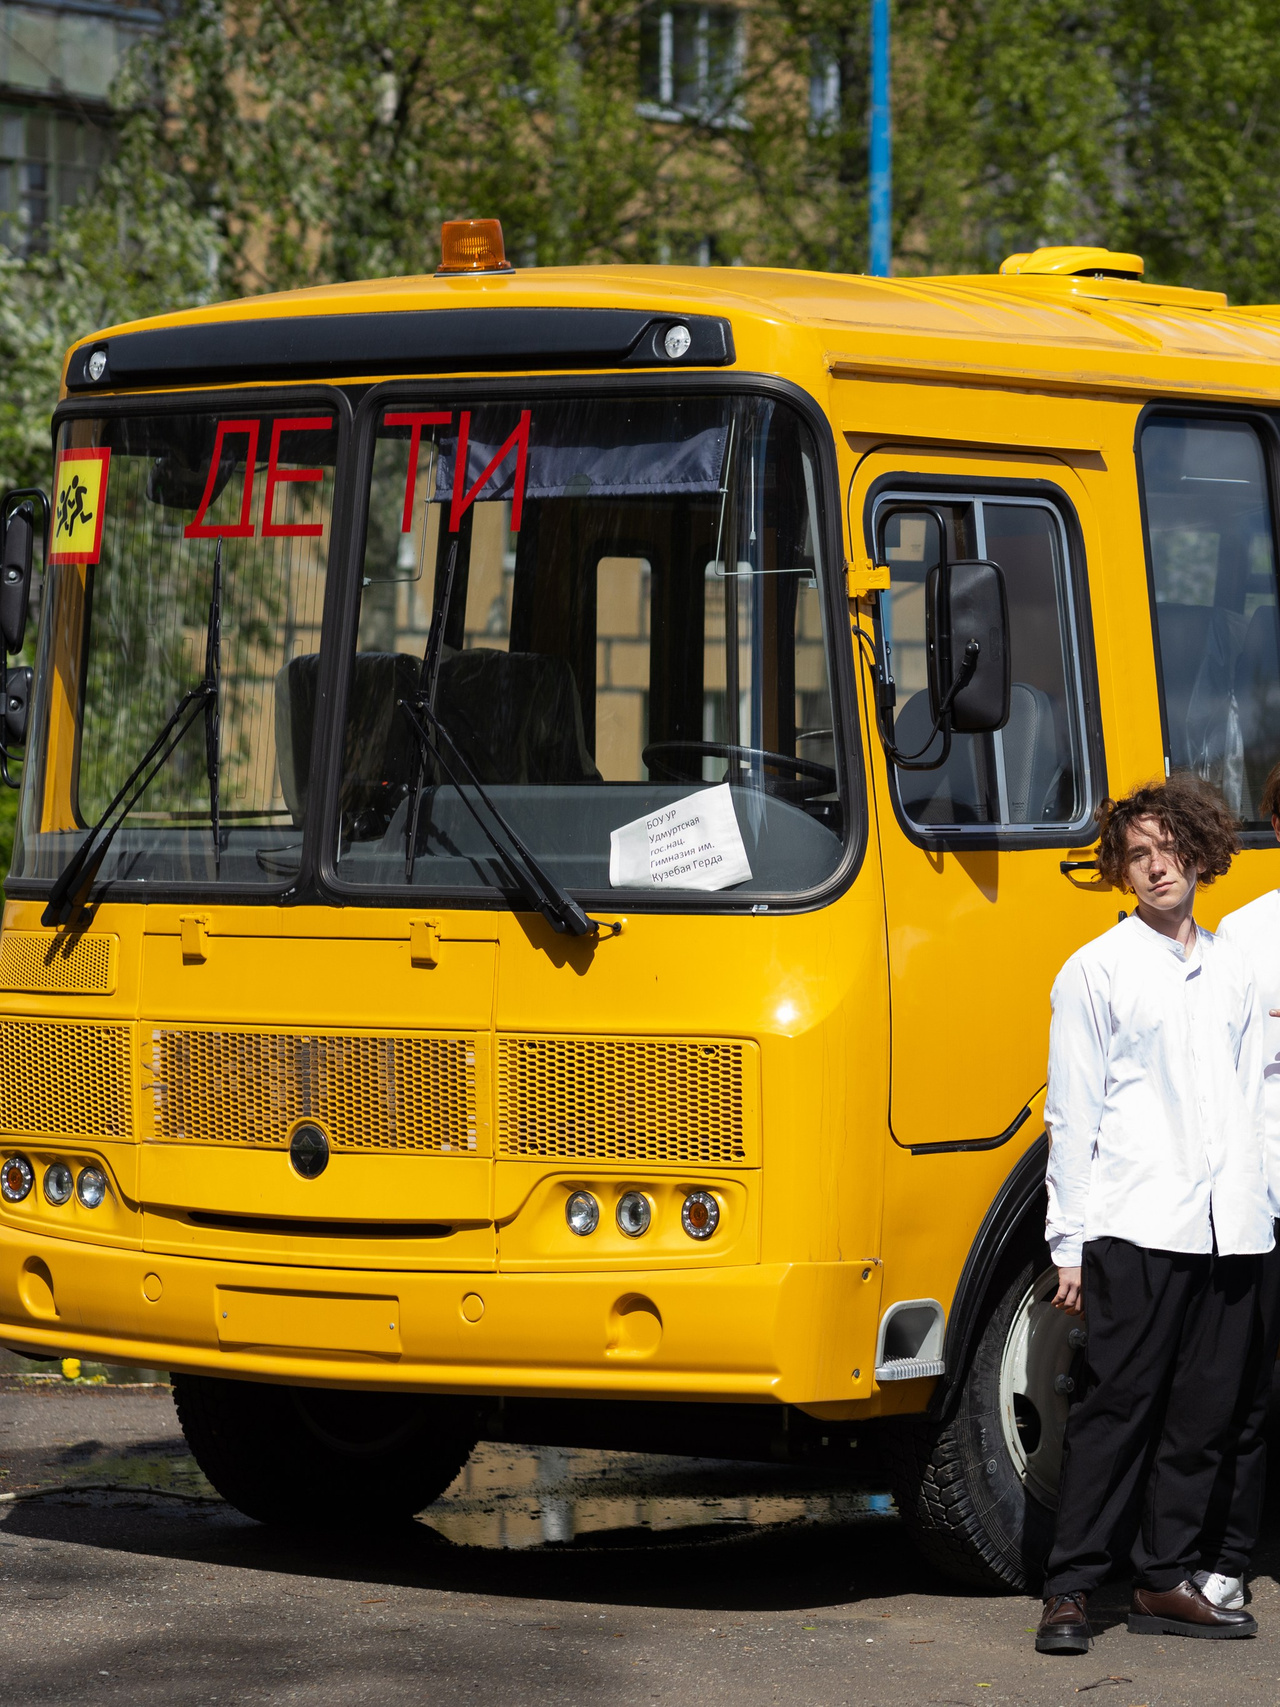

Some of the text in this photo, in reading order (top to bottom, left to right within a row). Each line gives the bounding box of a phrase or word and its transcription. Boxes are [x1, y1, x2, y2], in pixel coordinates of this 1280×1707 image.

[646, 815, 664, 830] БОУ
[649, 816, 700, 844] Удмуртская
[650, 842, 715, 868] Гимназия им.
[652, 854, 723, 883] Кузебая Герда
